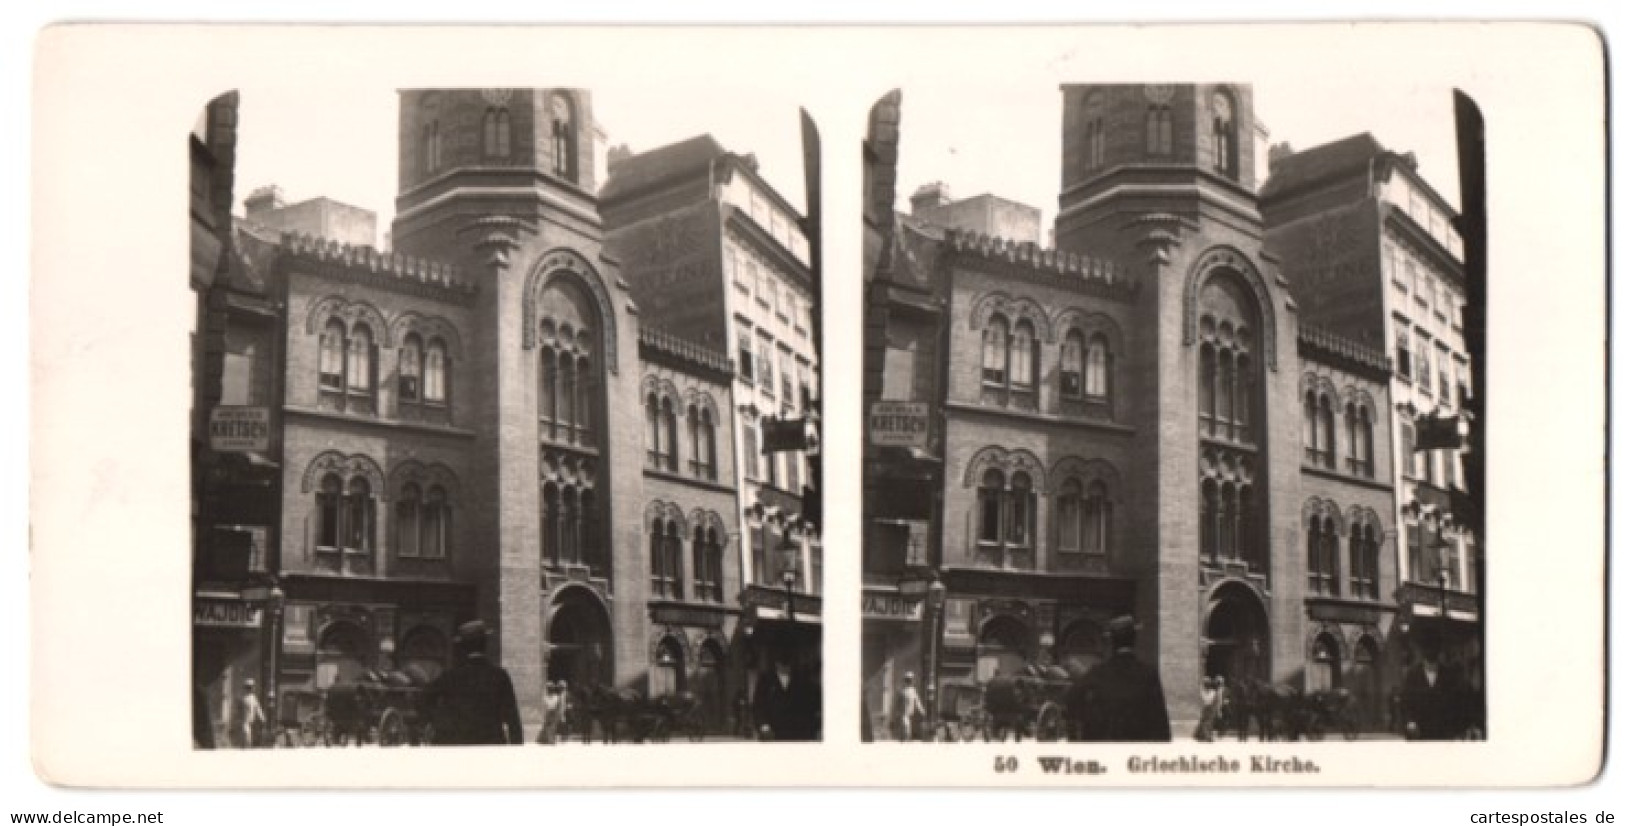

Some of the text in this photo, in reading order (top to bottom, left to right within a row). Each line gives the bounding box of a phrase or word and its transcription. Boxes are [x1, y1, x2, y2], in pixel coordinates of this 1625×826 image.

[1036, 756, 1108, 775] Wien.
[1126, 755, 1240, 774] Griechische
[1250, 755, 1321, 774] Kirche.
